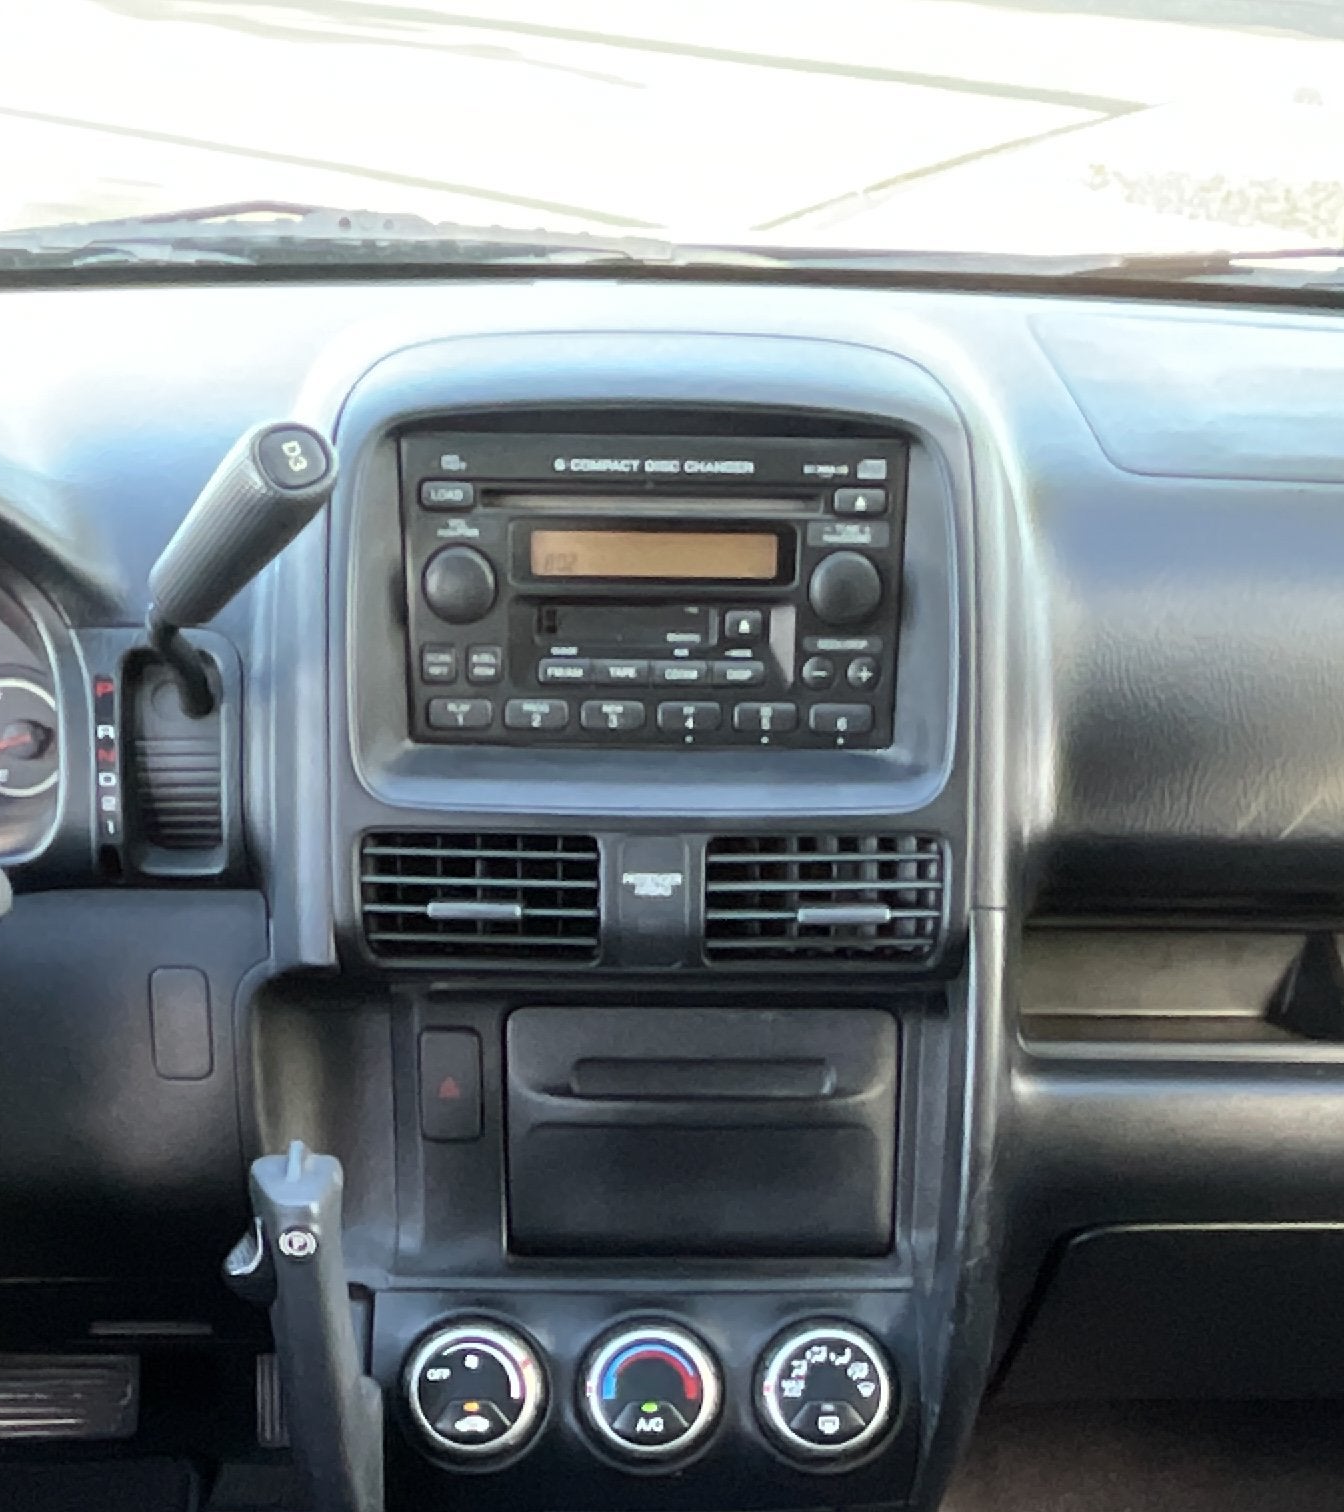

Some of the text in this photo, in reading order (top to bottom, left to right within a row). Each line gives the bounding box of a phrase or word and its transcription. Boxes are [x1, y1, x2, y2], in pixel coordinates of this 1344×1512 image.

[570, 457, 639, 473] COMPACT
[644, 459, 680, 474] DISC
[684, 459, 755, 475] CHANGER
[430, 488, 464, 502] LOAD
[96, 681, 114, 697] P
[98, 772, 117, 787] D
[426, 1367, 452, 1382] OFF
[635, 1416, 665, 1433] A/C
